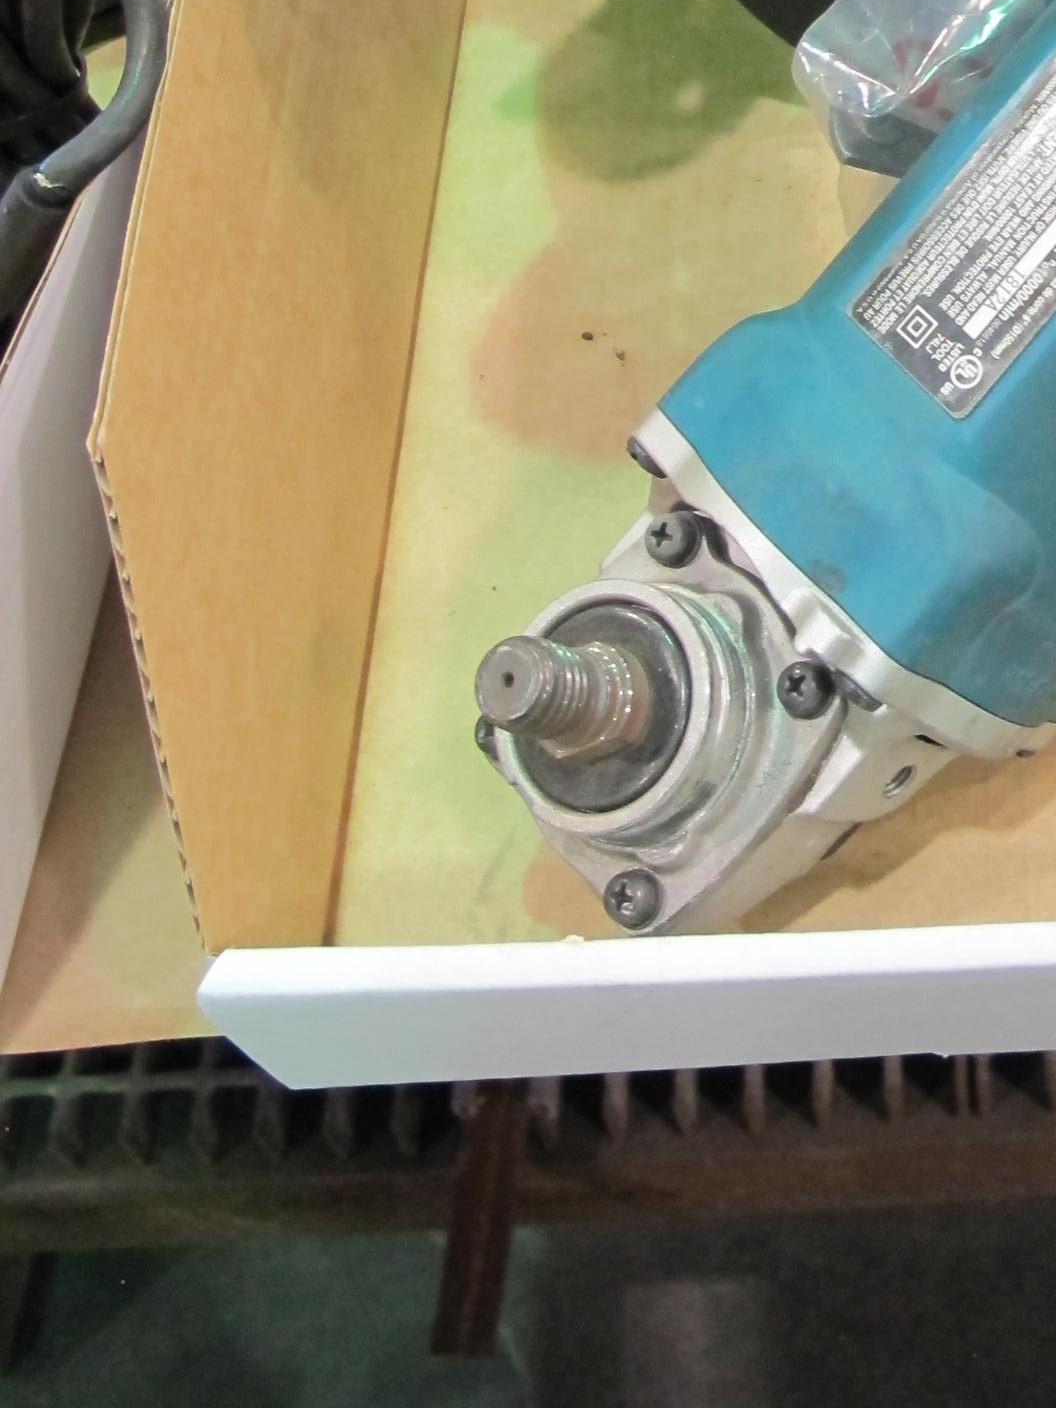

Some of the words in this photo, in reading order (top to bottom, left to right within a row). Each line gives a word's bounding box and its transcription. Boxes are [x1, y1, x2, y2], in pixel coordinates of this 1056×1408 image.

[1016, 171, 1030, 186] DE
[1030, 170, 1045, 185] AT
[1011, 180, 1037, 208] LEAST
[983, 210, 998, 225] LE
[1011, 189, 1056, 241] INSTRUCTION
[1016, 197, 1036, 218] AND
[924, 214, 967, 262] PROTECTEUR
[955, 227, 970, 242] ET
[962, 219, 990, 249] RISQUE
[998, 213, 1023, 239] WEAR
[1031, 218, 1047, 234] OF
[941, 237, 962, 259] BIEN
[954, 244, 969, 259] DE
[987, 234, 1005, 253] EYE
[886, 260, 915, 293] PREVUS
[899, 257, 931, 292] ADEQUAT
[995, 253, 1017, 277] USER
[901, 253, 948, 305] COMPRENDRE
[958, 269, 990, 305] ALWAYS
[980, 271, 1002, 295] MUST
[982, 266, 1027, 315] 1812A
[870, 287, 893, 311] POUR
[891, 287, 905, 302] ET
[937, 292, 956, 313] USE
[965, 289, 987, 313] READ
[1041, 285, 1056, 300] de
[861, 306, 877, 322] AU
[868, 297, 898, 329] PORTEZ
[893, 300, 908, 315] LE
[945, 299, 965, 320] USE
[953, 307, 972, 327] AND
[876, 310, 900, 336] MODE
[929, 337, 955, 364] TOOL
[935, 340, 966, 374] LISTED
[937, 379, 955, 397] US
